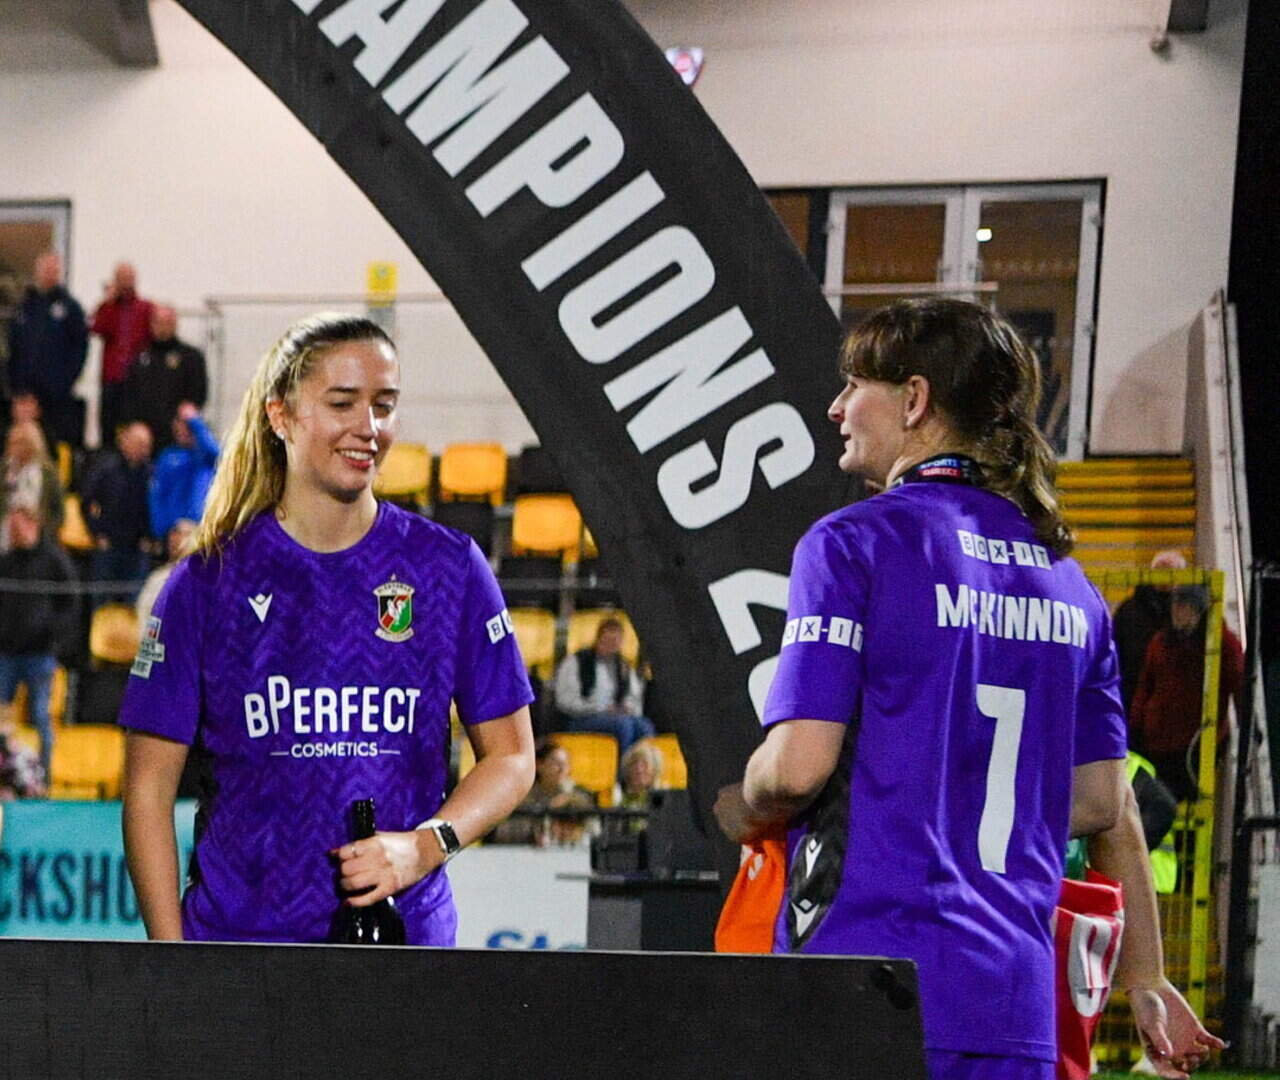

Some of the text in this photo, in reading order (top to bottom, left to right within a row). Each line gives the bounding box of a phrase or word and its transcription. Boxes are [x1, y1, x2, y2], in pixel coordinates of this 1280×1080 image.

[290, 0, 816, 530] AMPIONS
[244, 675, 421, 738] BPERFECT
[291, 742, 378, 758] COSMETICS
